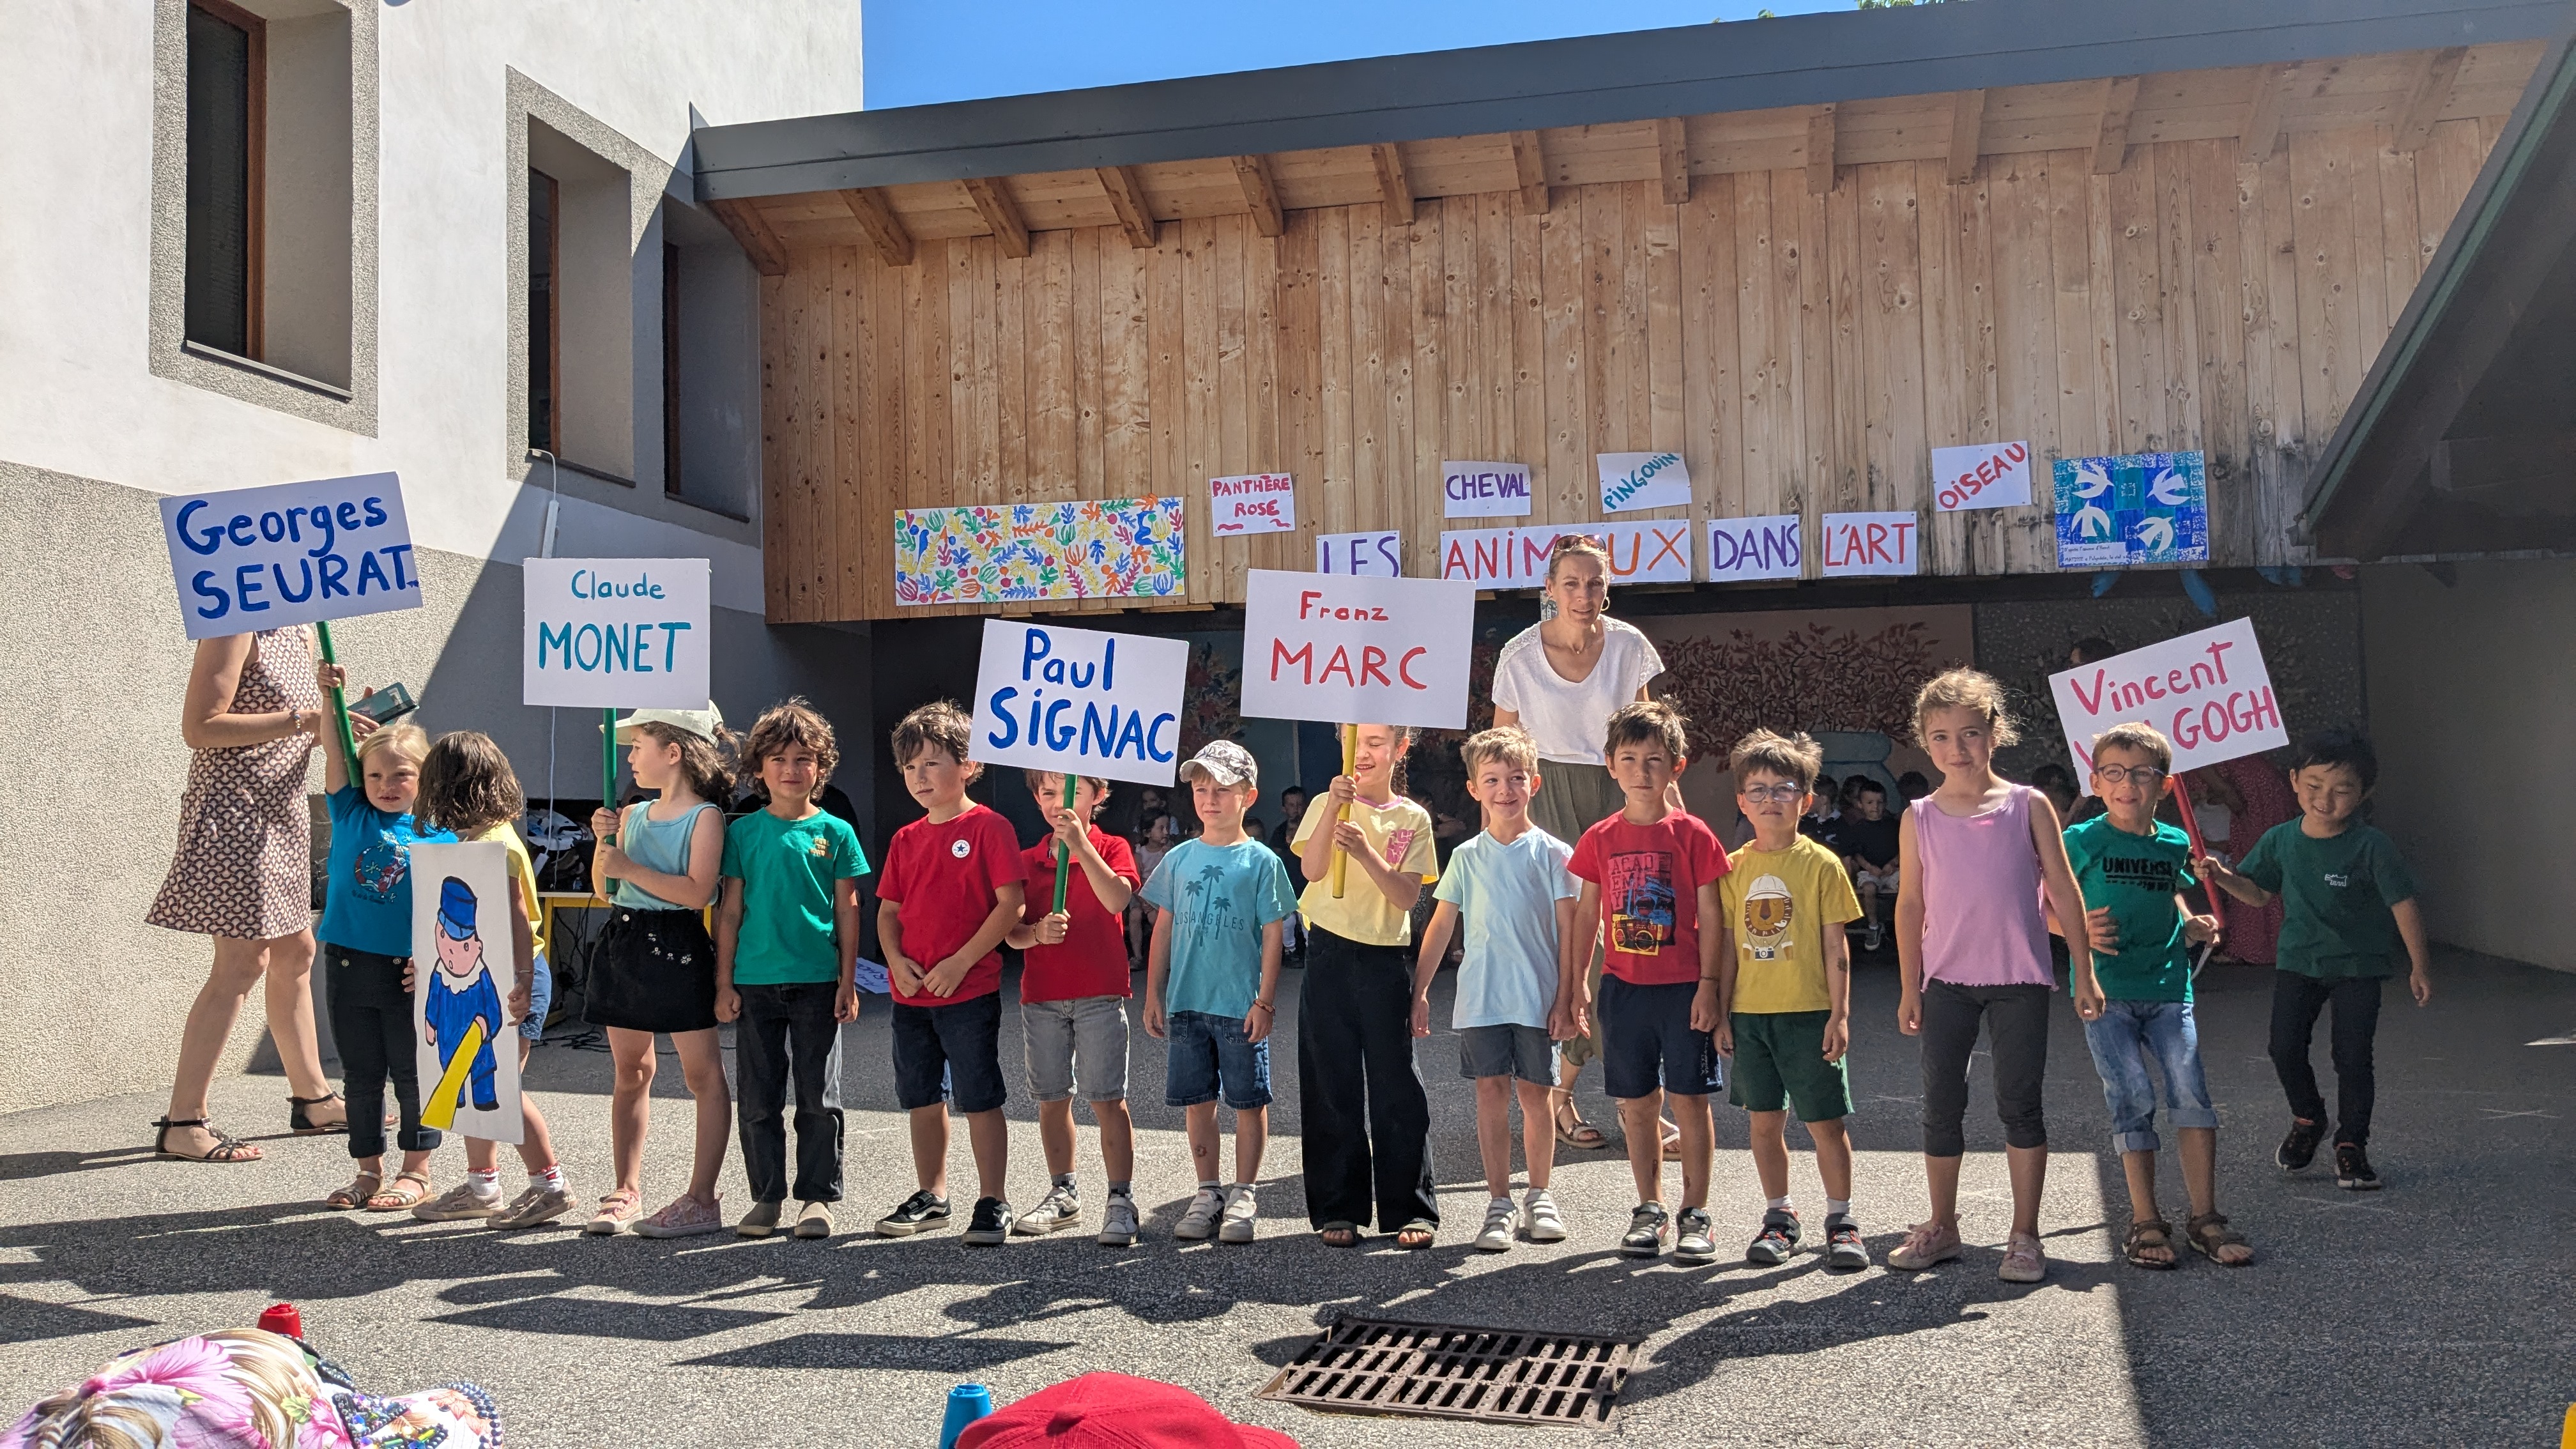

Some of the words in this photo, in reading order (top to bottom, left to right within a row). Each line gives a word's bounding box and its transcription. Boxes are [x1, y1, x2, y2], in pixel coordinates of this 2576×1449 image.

[1234, 500, 1280, 517] ROSE
[1446, 473, 1530, 501] CHEVAL
[176, 496, 387, 557] Georges
[1444, 528, 1686, 580] ANIMUX
[1713, 523, 1800, 571] DANS
[1825, 523, 1915, 566] L'ART
[192, 544, 417, 619] SEURAT
[571, 569, 666, 600] Claude
[1300, 590, 1389, 621] Franz
[539, 622, 692, 673] MONET
[1022, 628, 1115, 691] Paul
[1271, 638, 1427, 690] MARC
[2070, 641, 2233, 716] Vincent
[2173, 686, 2280, 750] GOGH
